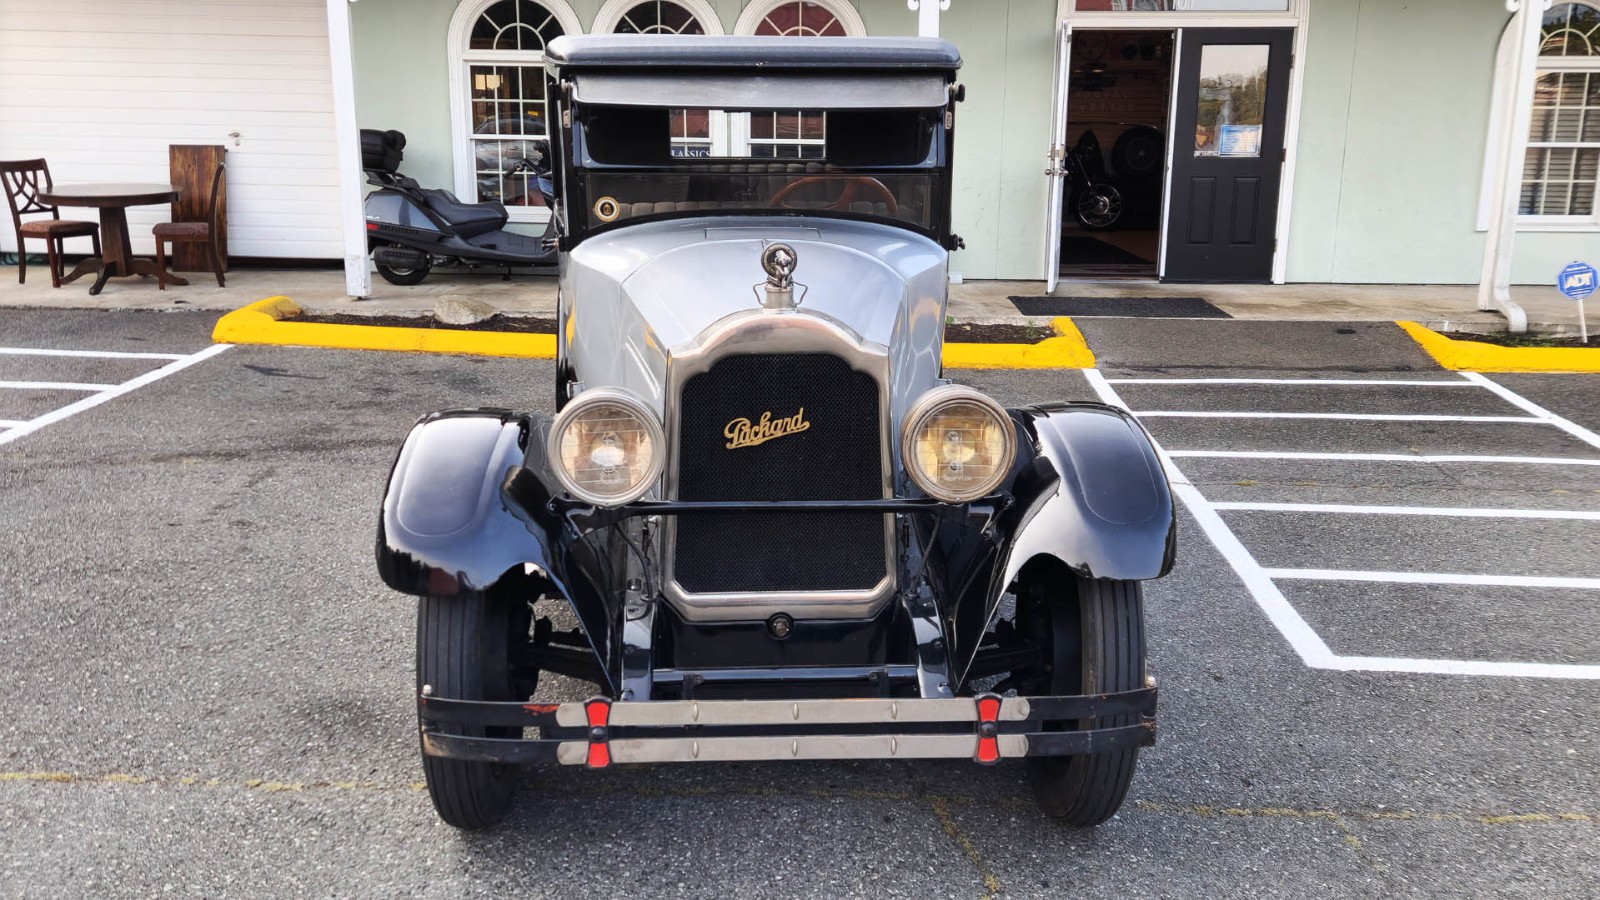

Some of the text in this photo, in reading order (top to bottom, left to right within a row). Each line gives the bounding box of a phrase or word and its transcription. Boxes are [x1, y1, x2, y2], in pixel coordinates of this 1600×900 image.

[671, 149, 712, 157] LASICS
[1565, 272, 1592, 289] ADT
[724, 407, 811, 449] Packard
